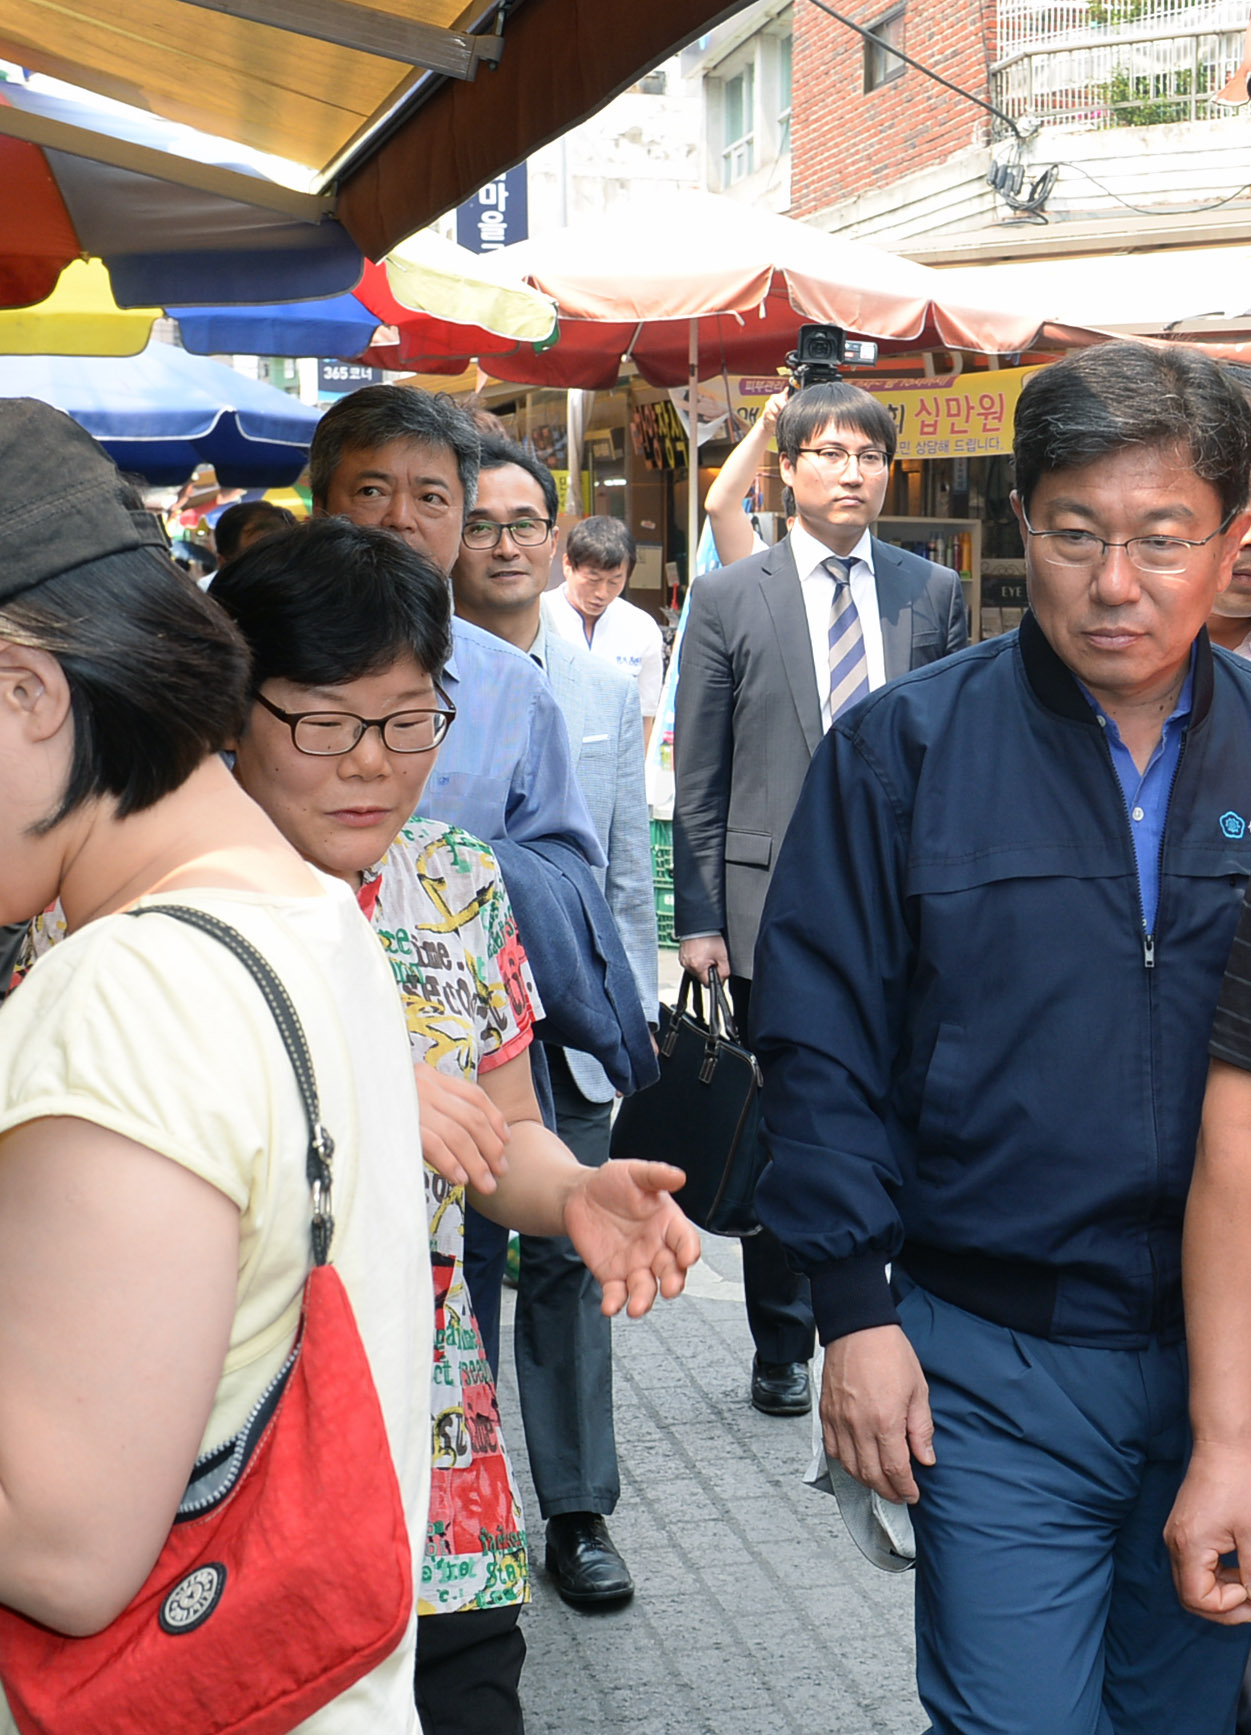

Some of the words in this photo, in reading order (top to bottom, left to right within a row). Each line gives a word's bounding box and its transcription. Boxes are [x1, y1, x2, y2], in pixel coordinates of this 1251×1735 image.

[914, 392, 1006, 436] 십만원
[915, 439, 950, 455] 상담해
[954, 436, 1004, 452] 드립니다.
